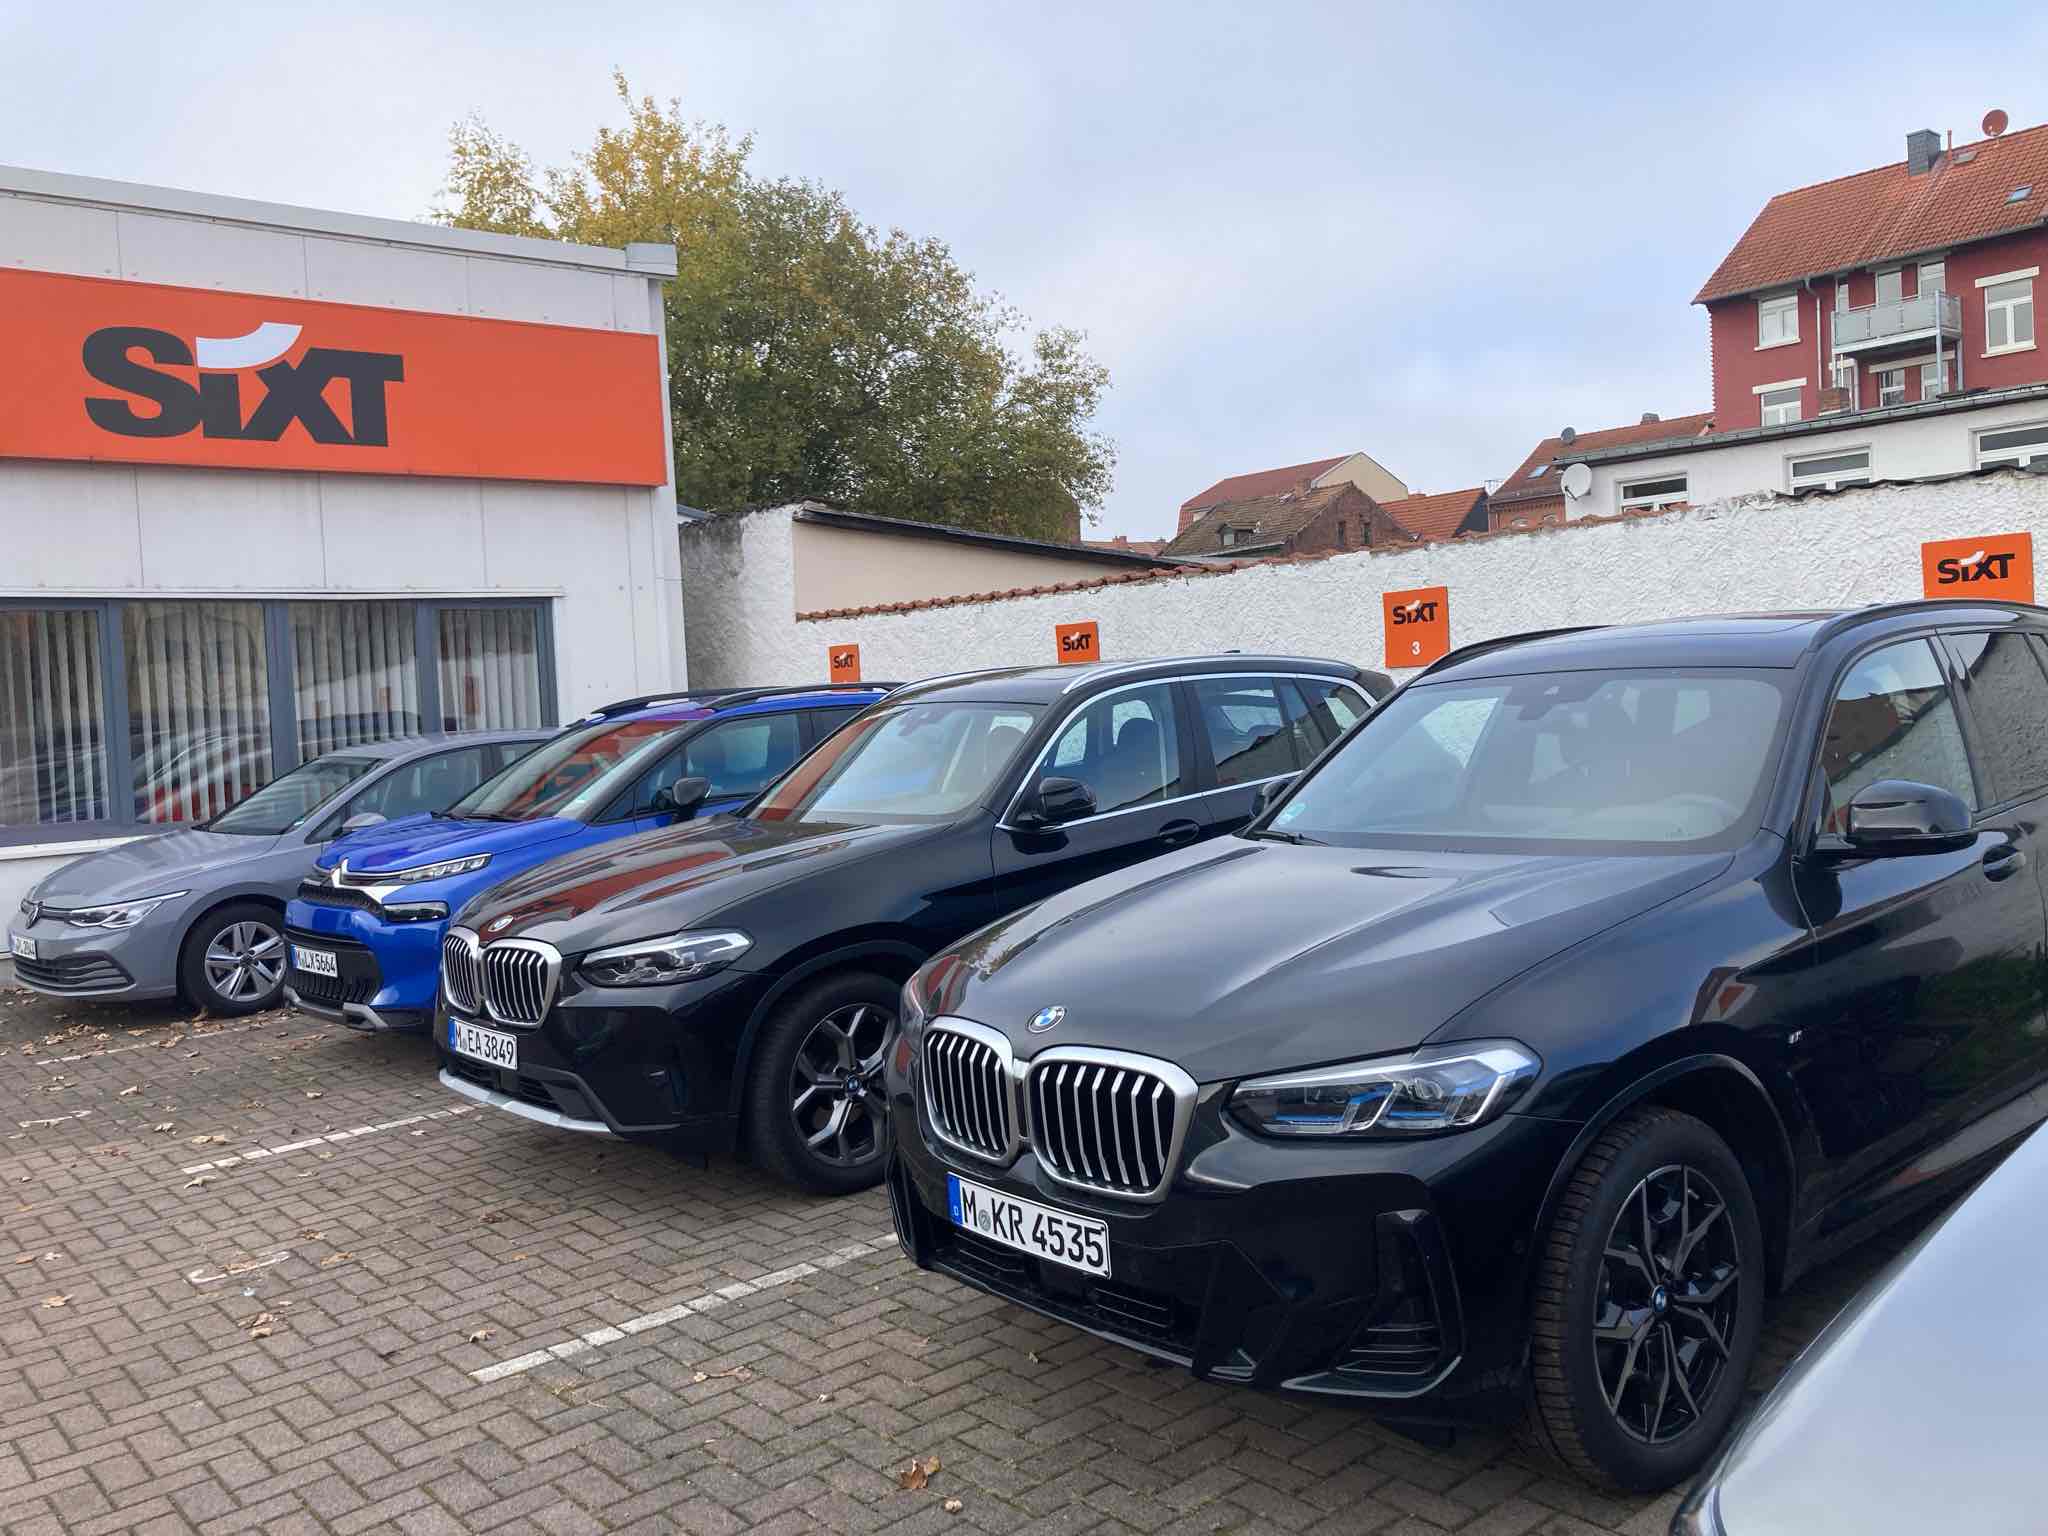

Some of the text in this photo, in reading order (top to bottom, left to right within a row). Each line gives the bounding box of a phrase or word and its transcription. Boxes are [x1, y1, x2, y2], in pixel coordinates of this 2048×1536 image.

[1411, 640, 1421, 656] 3
[467, 1029, 482, 1056] EA
[484, 1033, 514, 1065] 3849
[962, 1186, 1104, 1268] M KR 4535
